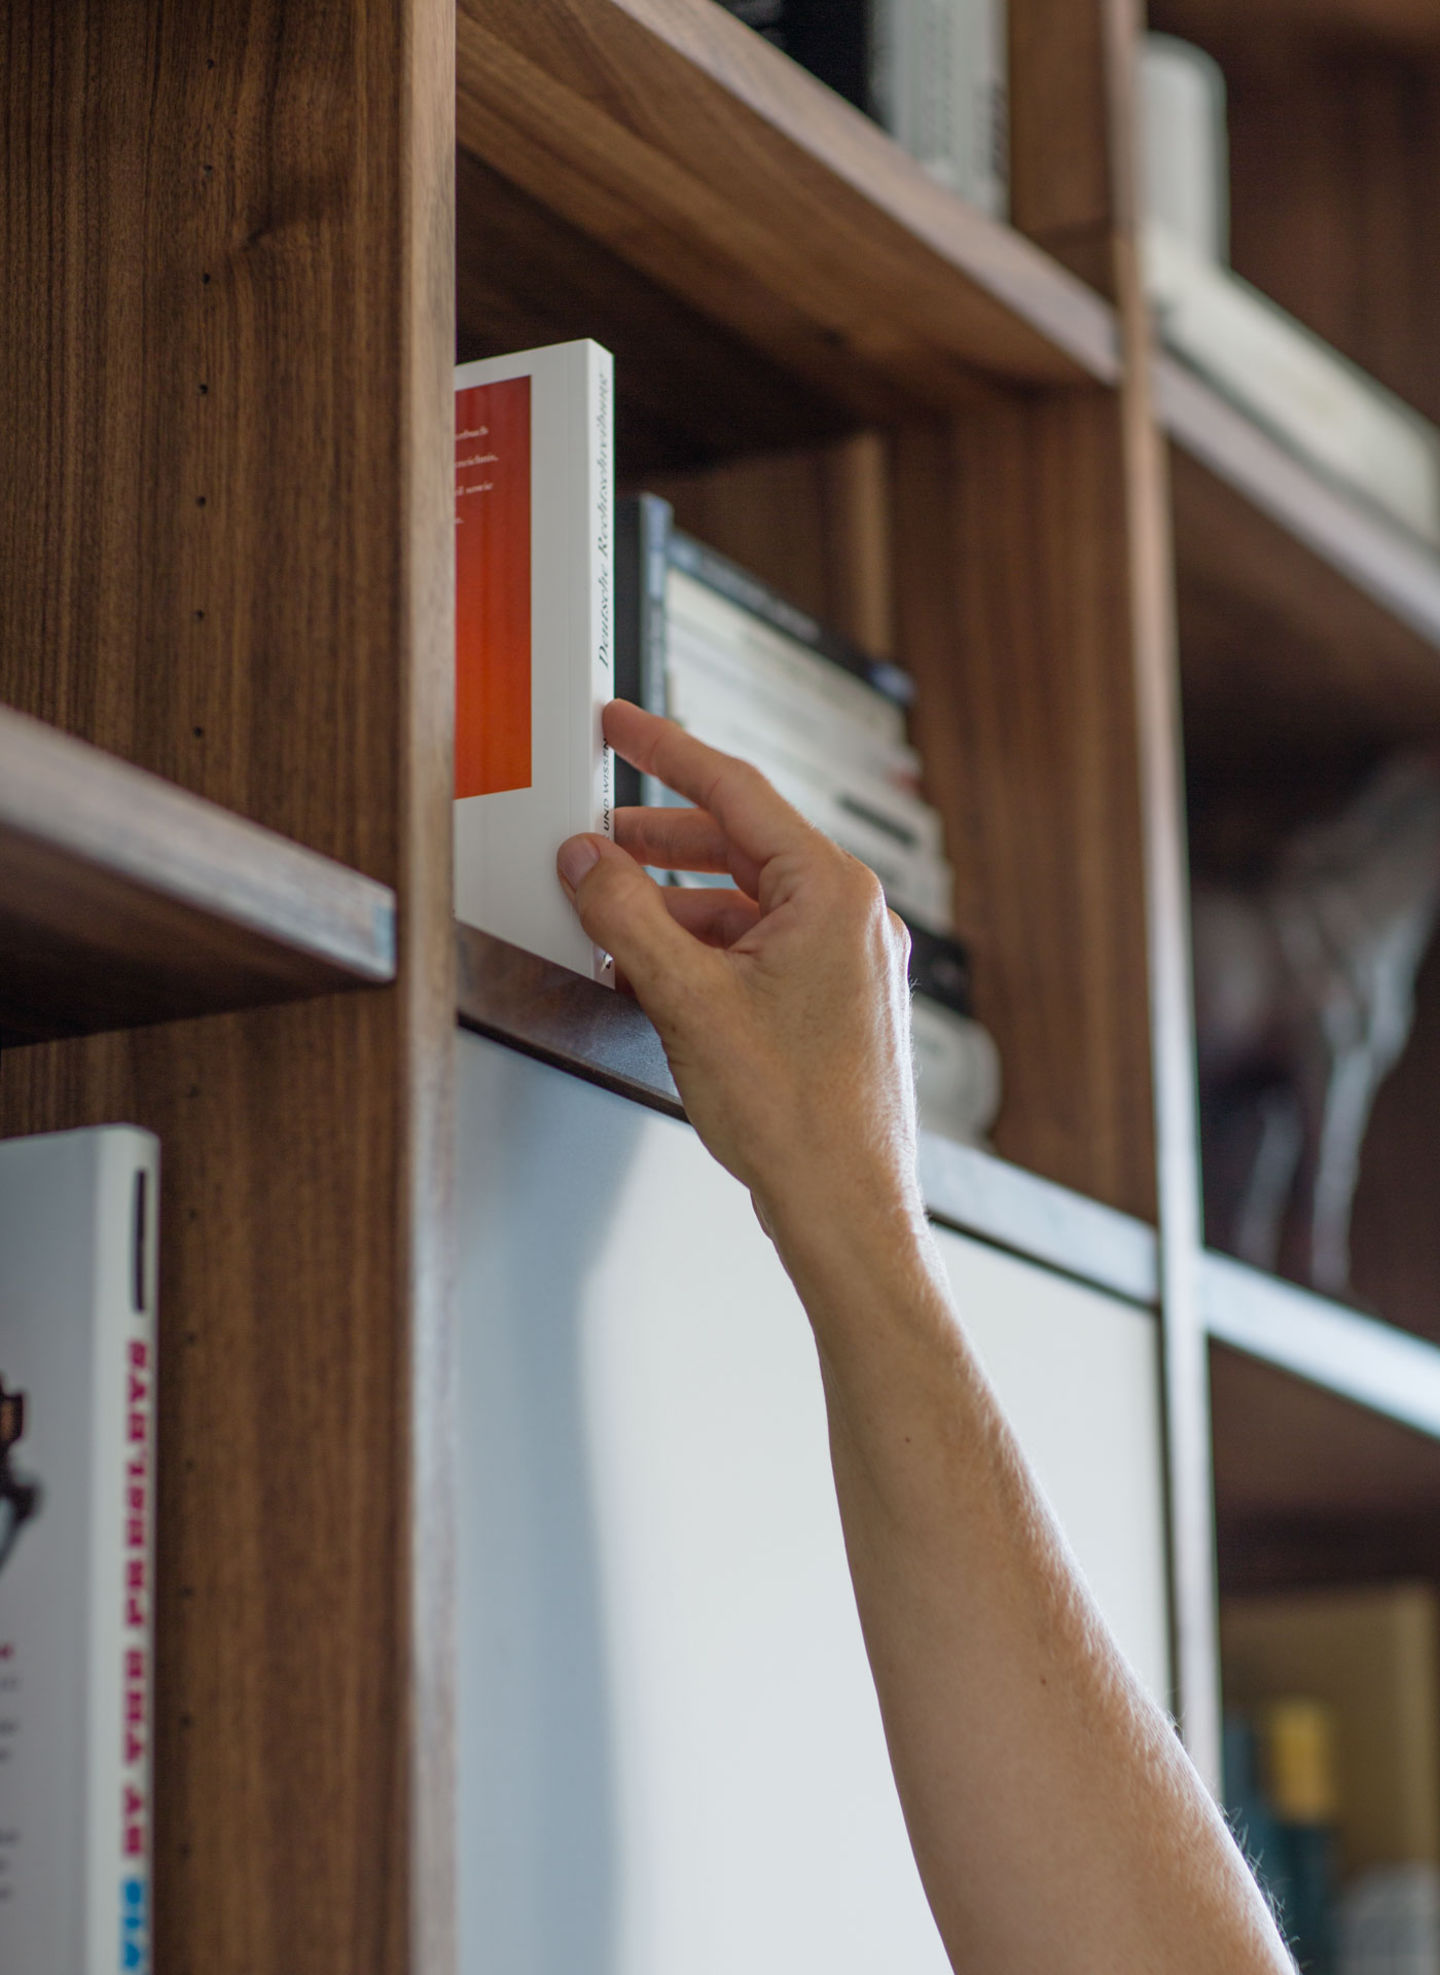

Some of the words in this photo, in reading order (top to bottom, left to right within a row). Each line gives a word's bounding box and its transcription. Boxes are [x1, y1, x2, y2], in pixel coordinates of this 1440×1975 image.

[597, 373, 609, 559] Rechtschreibung
[597, 563, 609, 671] Deutsche
[602, 737, 610, 793] WISSEN
[602, 798, 610, 832] UND
[125, 1340, 147, 1628] PRESLEYS
[125, 1649, 145, 1764] THE
[124, 1786, 143, 1857] BY
[120, 1878, 146, 1973] VIS
